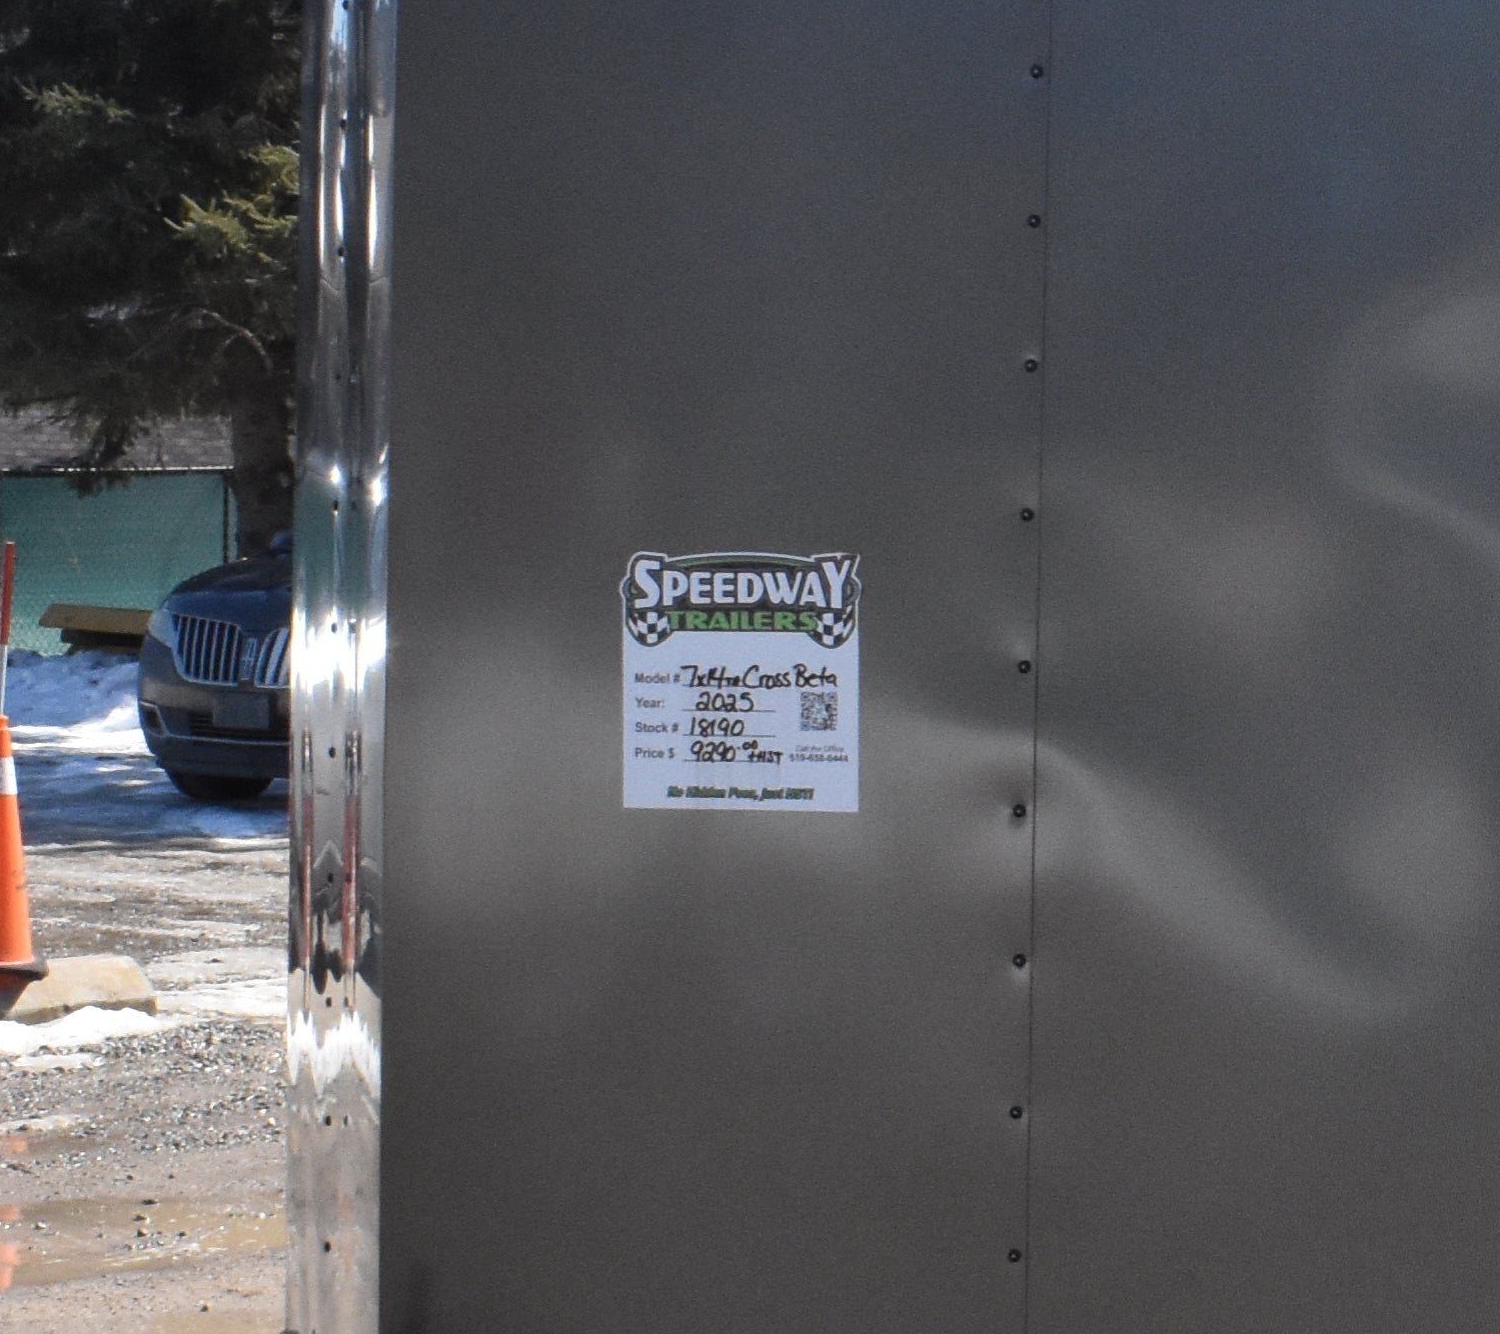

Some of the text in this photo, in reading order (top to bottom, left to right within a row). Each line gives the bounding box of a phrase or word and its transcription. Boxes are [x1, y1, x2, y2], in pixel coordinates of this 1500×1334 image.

[634, 558, 851, 609] SPEEDWAY
[664, 610, 819, 632] TRAILERS
[634, 673, 670, 684] Model
[742, 665, 792, 689] Cross
[793, 663, 838, 687] Beta
[635, 691, 754, 713] Year: 2025
[635, 721, 668, 733] Stock
[690, 717, 745, 738] 18190
[635, 747, 665, 759] Price
[668, 747, 676, 759] $
